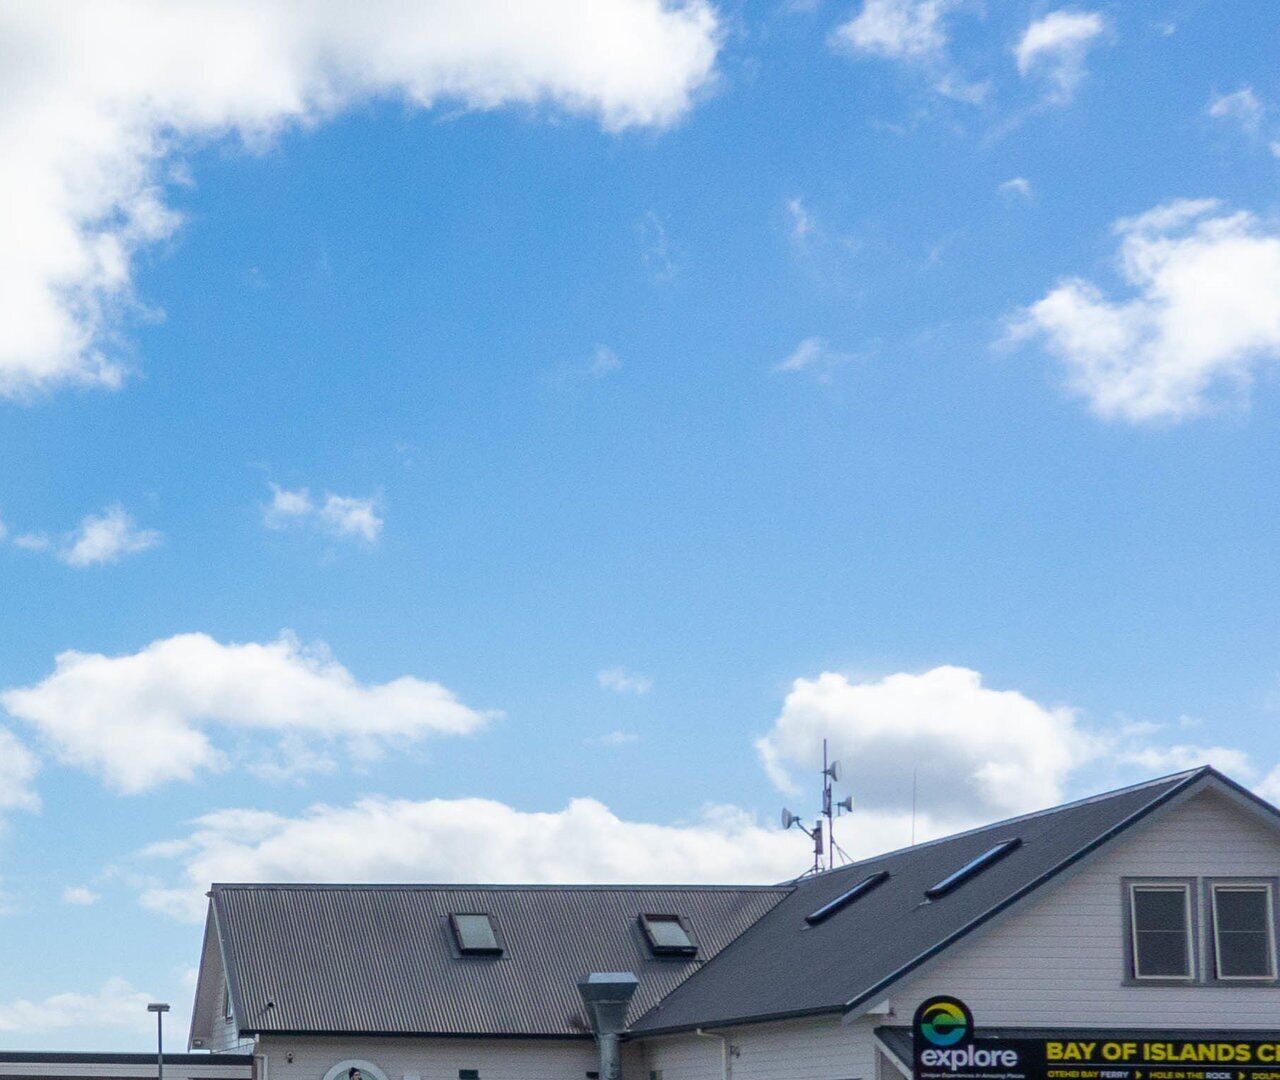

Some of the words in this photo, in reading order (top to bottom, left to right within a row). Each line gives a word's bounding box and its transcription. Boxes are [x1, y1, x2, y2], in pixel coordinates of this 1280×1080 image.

[921, 1044, 1018, 1071] explore
[1046, 1042, 1096, 1060] BAY
[1102, 1042, 1137, 1060] OF
[1143, 1043, 1251, 1061] ISLANDS
[1257, 1044, 1280, 1062] C
[1080, 1070, 1099, 1078] BAY
[1100, 1070, 1129, 1079] FERRY
[1149, 1071, 1173, 1079] HOLE
